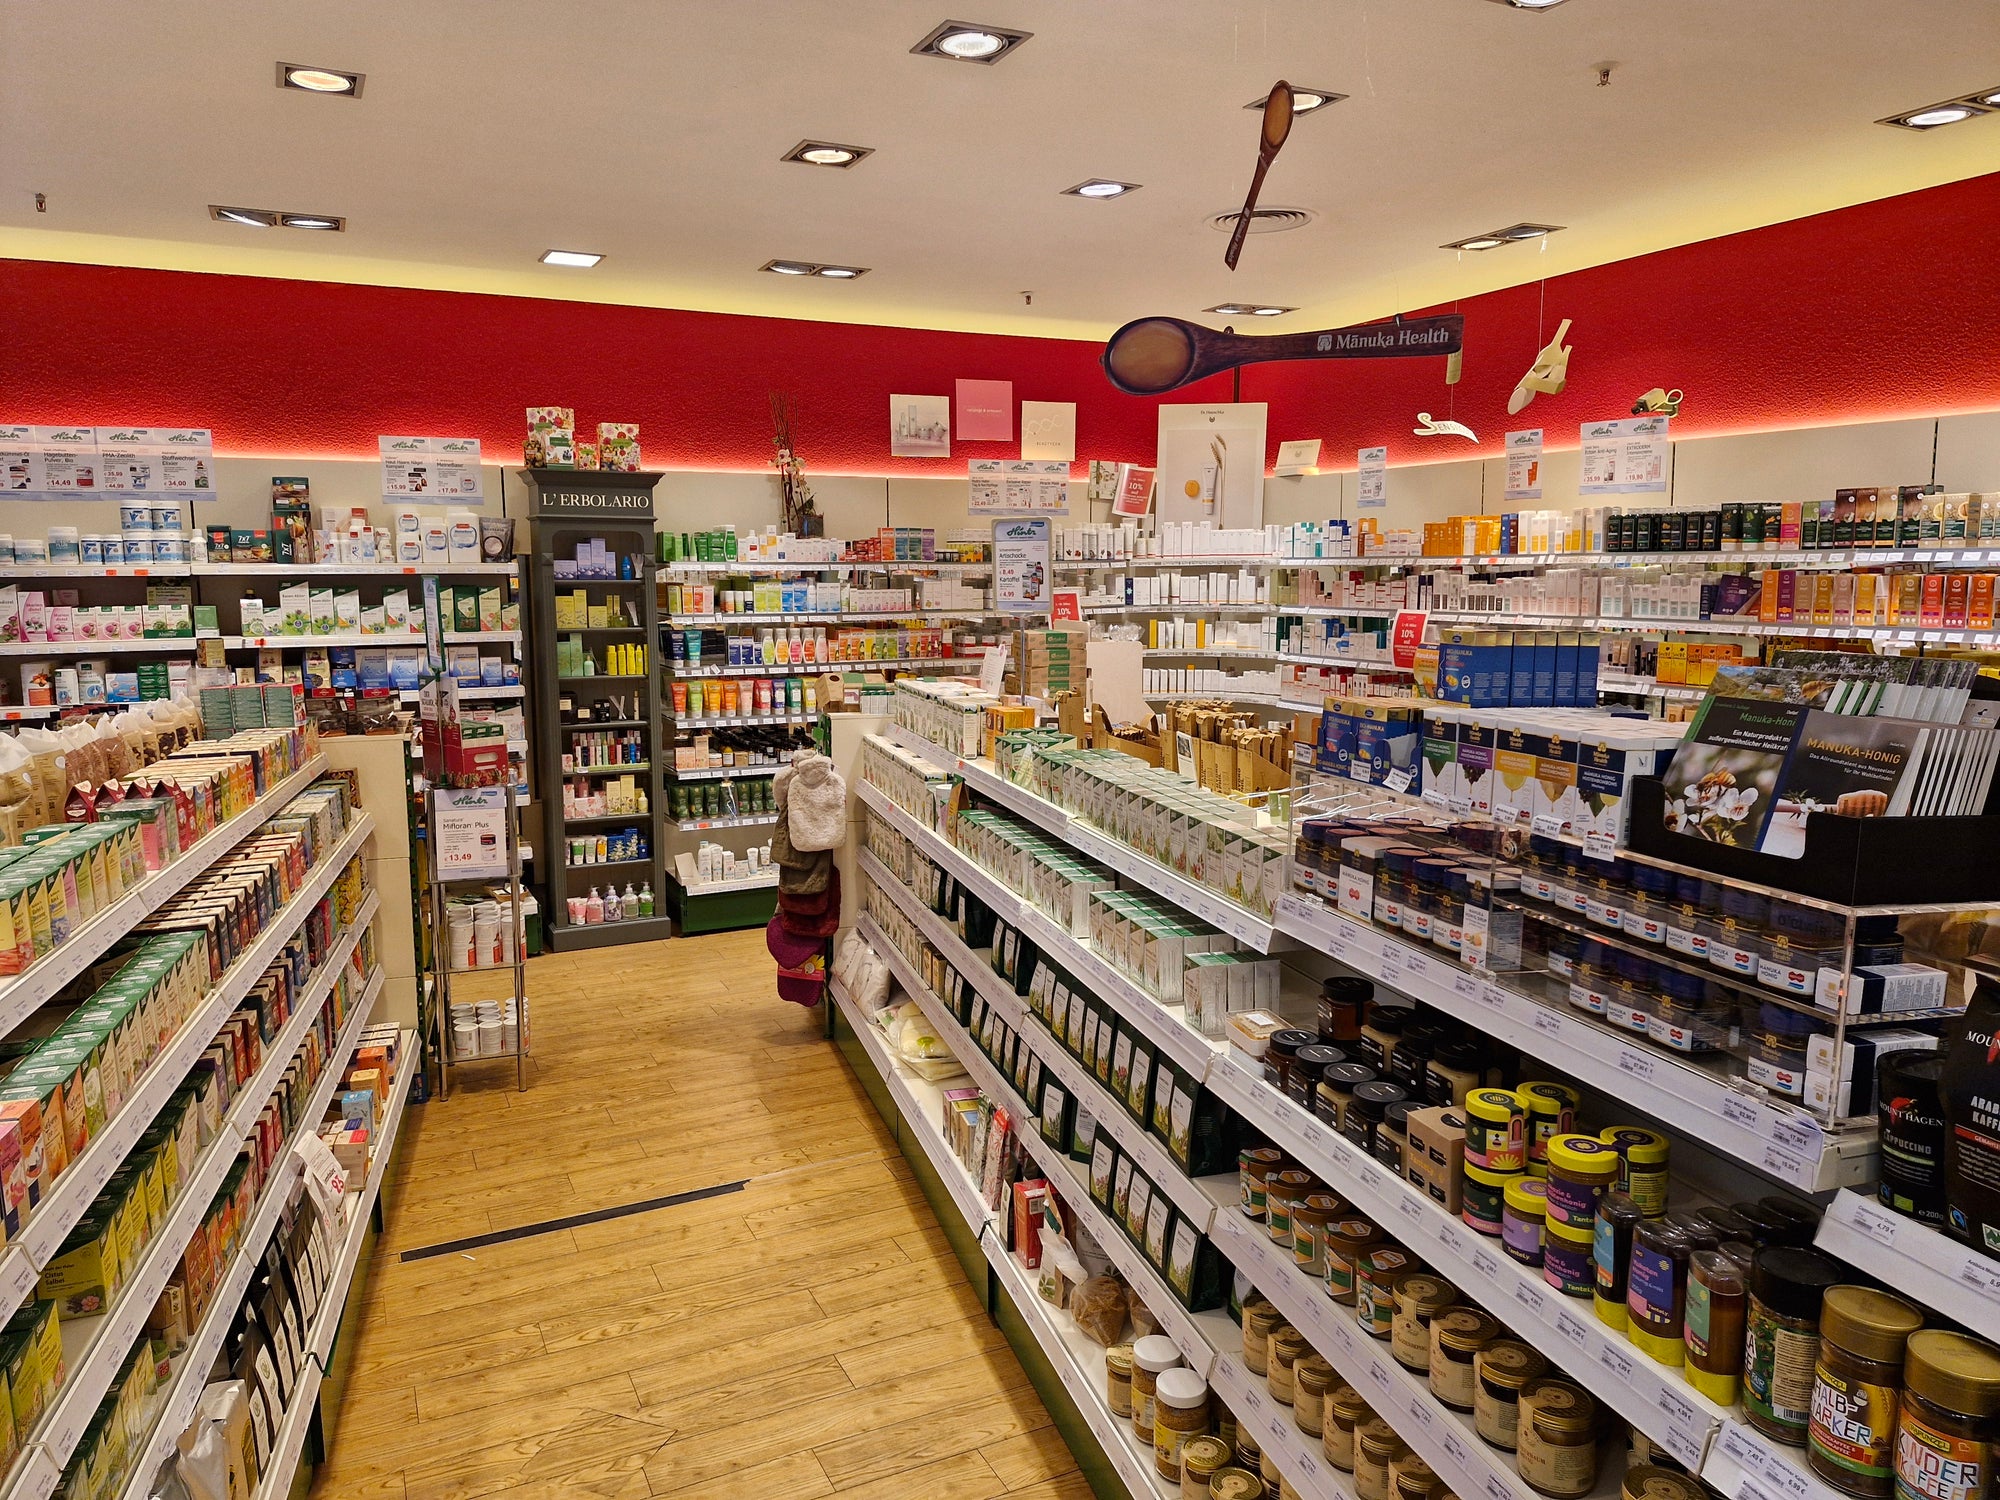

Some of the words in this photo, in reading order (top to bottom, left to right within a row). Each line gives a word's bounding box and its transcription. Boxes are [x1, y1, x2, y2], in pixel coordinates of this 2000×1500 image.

[1400, 328, 1449, 346] Health
[1007, 525, 1037, 537] Hintz
[1057, 607, 1071, 616] 10%
[1401, 629, 1415, 639] 10%
[1739, 712, 1796, 727] Manuka-Honi
[1733, 729, 1743, 737] Ein
[1743, 730, 1782, 743] Naturprodukt
[1807, 738, 1901, 764] MANUKA-HONIG
[1809, 752, 1820, 760] Das
[1820, 754, 1857, 768] Allroundtalent
[1867, 763, 1896, 775] Neuseeland
[453, 795, 489, 806] Hintz
[474, 821, 490, 829] Plus
[449, 853, 472, 862] 13,49
[1879, 1099, 1905, 1120] MOUNT
[1905, 1113, 1944, 1127] HAGEN
[1883, 1130, 1932, 1155] CAPPUCCINO
[1573, 1215, 1594, 1223] Tante
[1877, 1223, 1890, 1232] 4,79
[1751, 1373, 1765, 1388] FAIR
[1815, 1381, 1859, 1414] HALB-
[1909, 1423, 1949, 1451] RAPUNZEL
[1900, 1429, 1979, 1486] KINDER
[1788, 1478, 1801, 1491] 6,99
